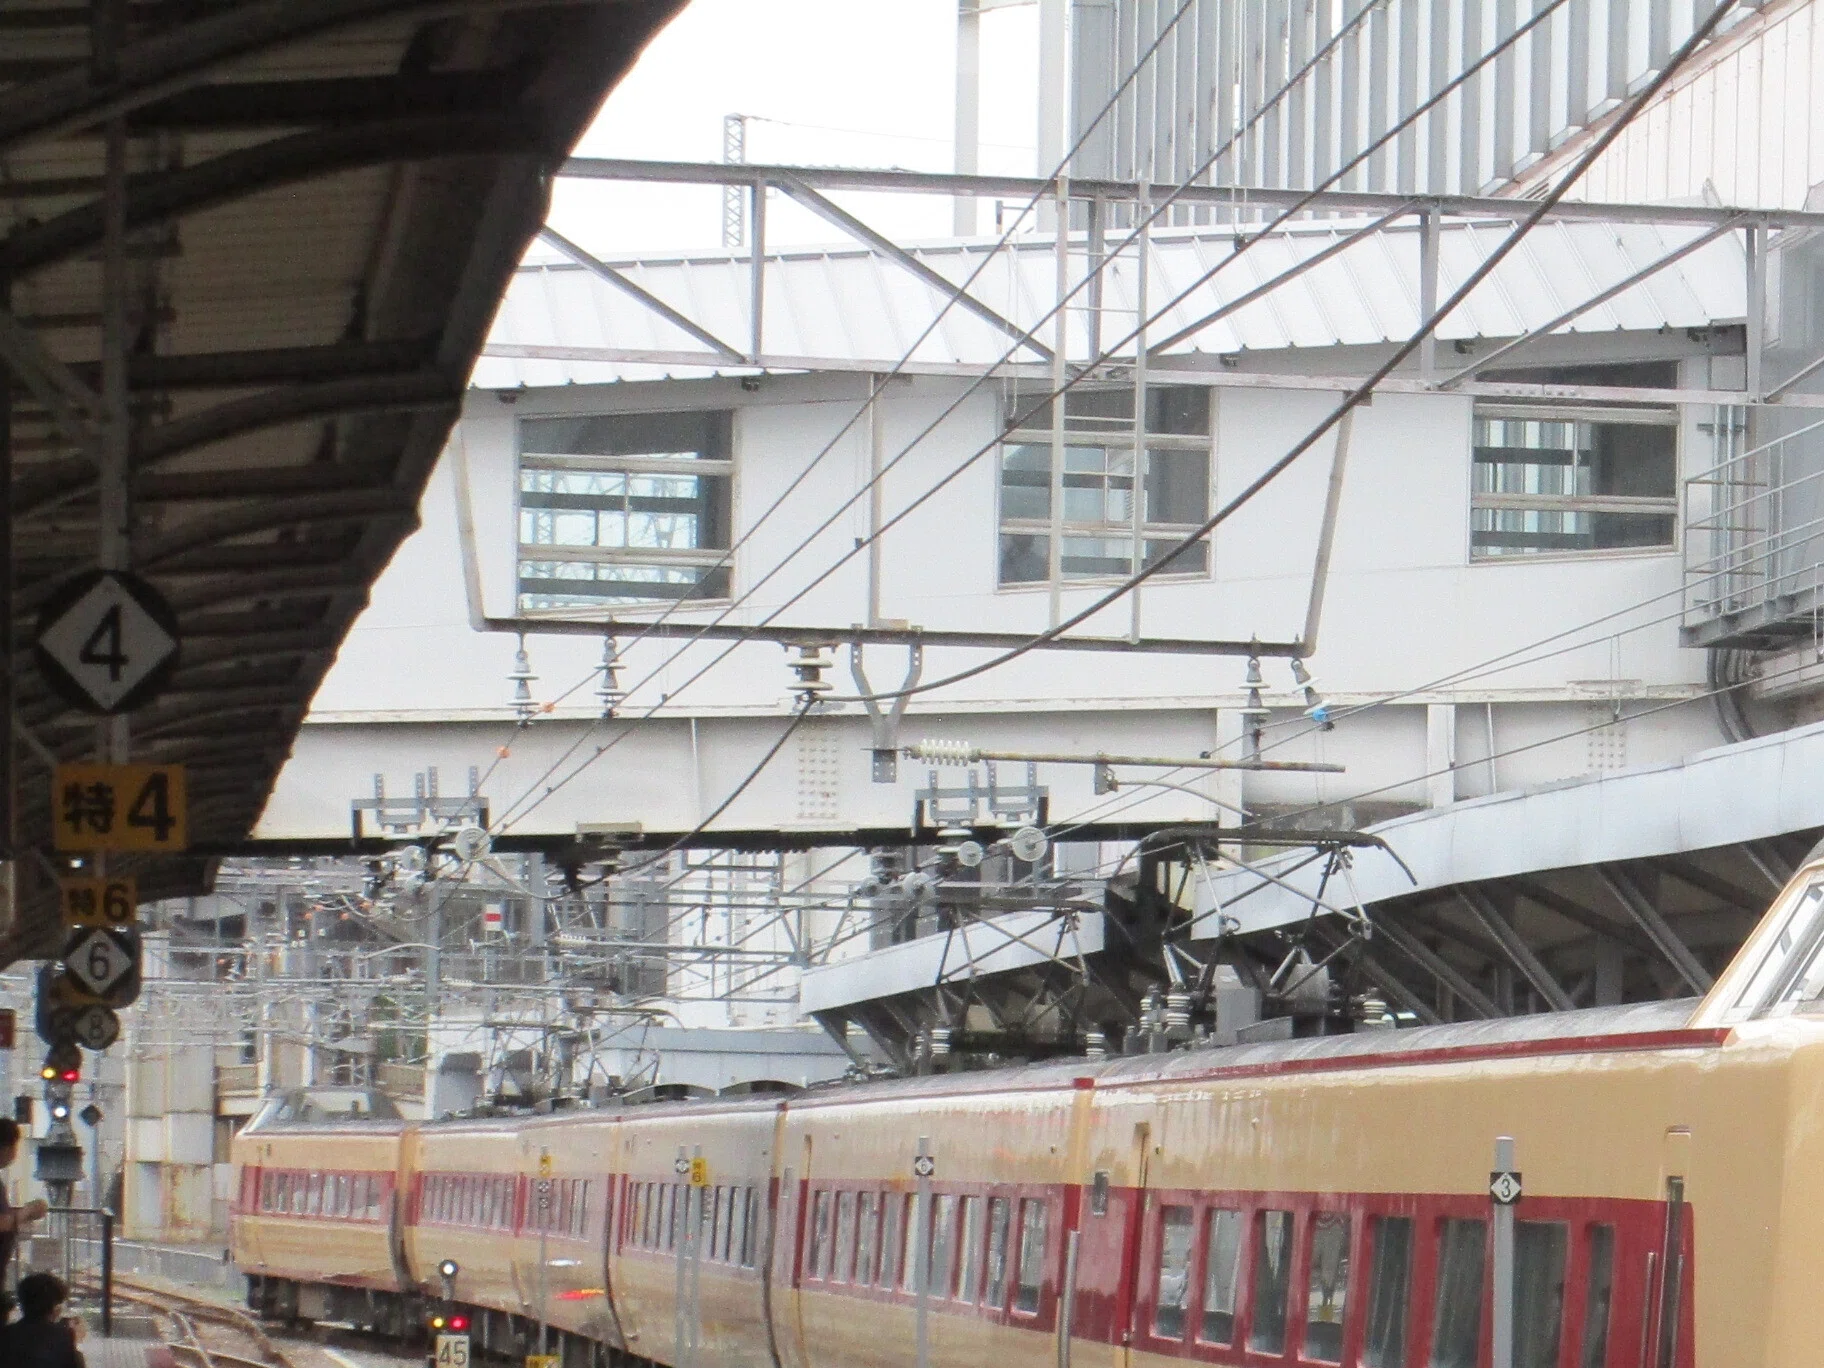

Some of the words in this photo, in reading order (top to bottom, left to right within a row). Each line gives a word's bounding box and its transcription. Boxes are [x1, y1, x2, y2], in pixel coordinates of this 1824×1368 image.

[80, 604, 129, 682] 4
[62, 772, 176, 842] 特4
[89, 941, 109, 981] 6
[1501, 1178, 1511, 1199] 3
[439, 1340, 467, 1367] 45
